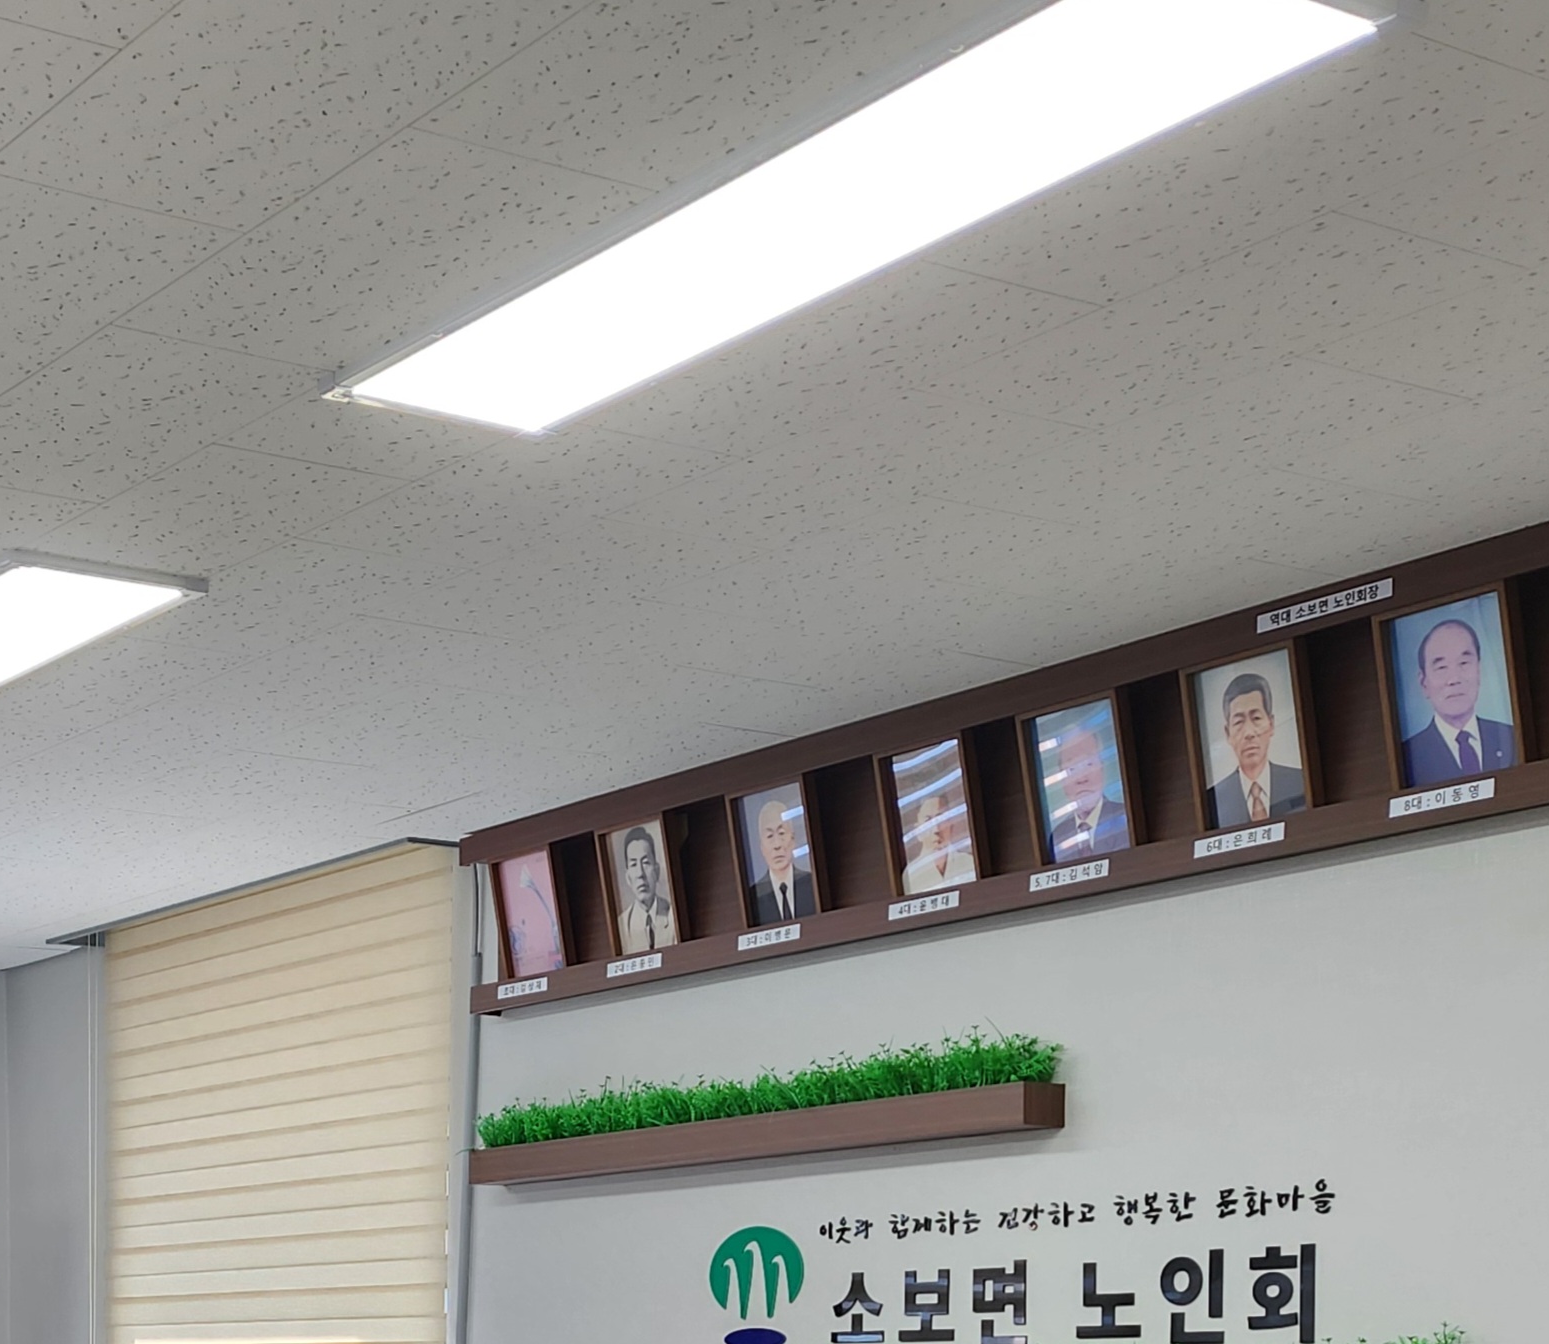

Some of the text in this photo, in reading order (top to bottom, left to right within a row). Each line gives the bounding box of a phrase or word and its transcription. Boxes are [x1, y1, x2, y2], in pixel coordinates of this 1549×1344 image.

[1269, 584, 1380, 626] 역대 소보면 노인회장
[819, 1178, 1336, 1244] 이웃과 함께하는 건강하고 행복한 문화마을
